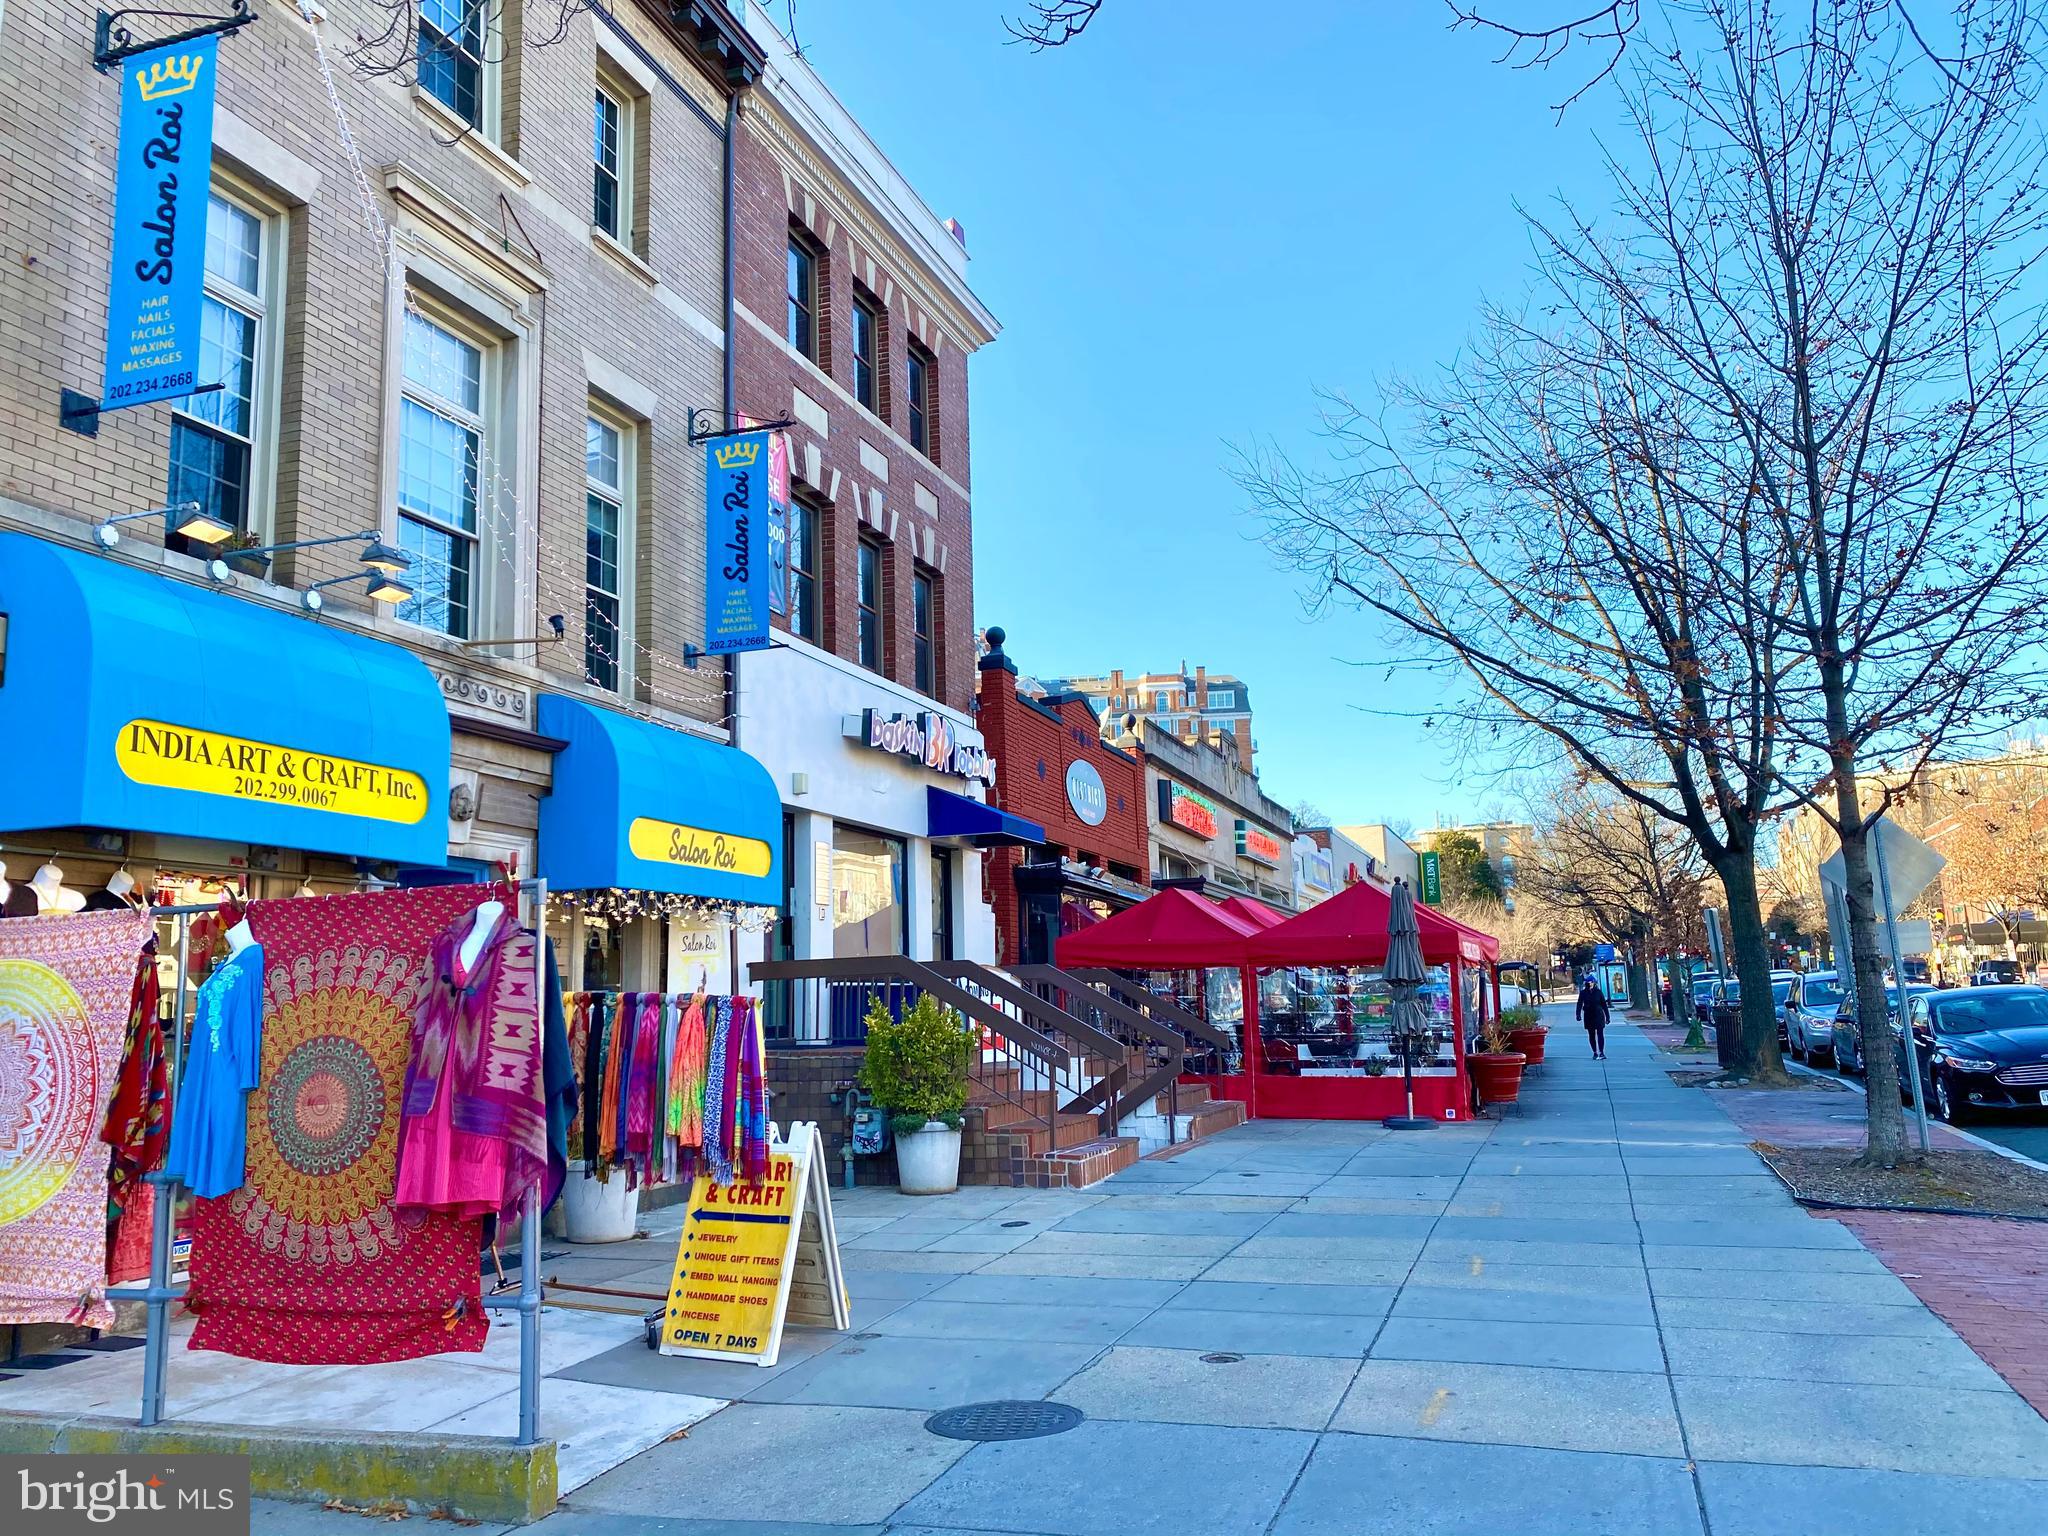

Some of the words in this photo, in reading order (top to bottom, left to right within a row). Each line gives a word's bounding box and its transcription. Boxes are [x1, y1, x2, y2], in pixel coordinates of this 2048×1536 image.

[143, 102, 183, 169] Roi
[135, 172, 179, 285] Salon
[142, 295, 169, 309] HAIR
[138, 309, 171, 325] NAILS
[131, 323, 175, 341] FACIALS
[130, 338, 175, 356] WAXING
[122, 351, 182, 373] MASSAGES
[110, 371, 193, 399] 202.234.2668
[723, 471, 750, 512] Roi
[723, 514, 749, 583] Salon
[726, 598, 749, 606] NAILS
[728, 589, 747, 597] HAIR
[722, 606, 752, 615] FACIALS
[716, 623, 758, 634] MASSAGES
[722, 615, 753, 625] WAXING
[709, 636, 766, 650] 202.234.2668
[130, 724, 212, 766] INDIA
[217, 742, 272, 775] ART
[276, 752, 296, 779] &
[302, 756, 382, 797] CRAFT,
[386, 772, 417, 800] Inc.
[234, 775, 337, 807] 202.299.0067
[669, 827, 711, 865] Salon
[713, 835, 736, 869] Roi
[681, 933, 704, 952] Salon
[705, 1183, 718, 1203] &
[727, 1184, 785, 1207] CRAFT
[697, 1233, 738, 1244] JEWELRY
[694, 1252, 727, 1262] UNIQUE
[730, 1255, 750, 1264] GIFT
[752, 1256, 780, 1266] ITEMS
[690, 1271, 714, 1281] EMBD
[717, 1274, 739, 1283] WALL
[742, 1276, 778, 1286] HANGING
[686, 1291, 735, 1303] HANDMADE
[738, 1296, 768, 1306] SHOES
[681, 1310, 720, 1322] INCENSE
[674, 1329, 710, 1343] OPEN
[715, 1334, 722, 1345] 7
[726, 1335, 758, 1349] DAYS
